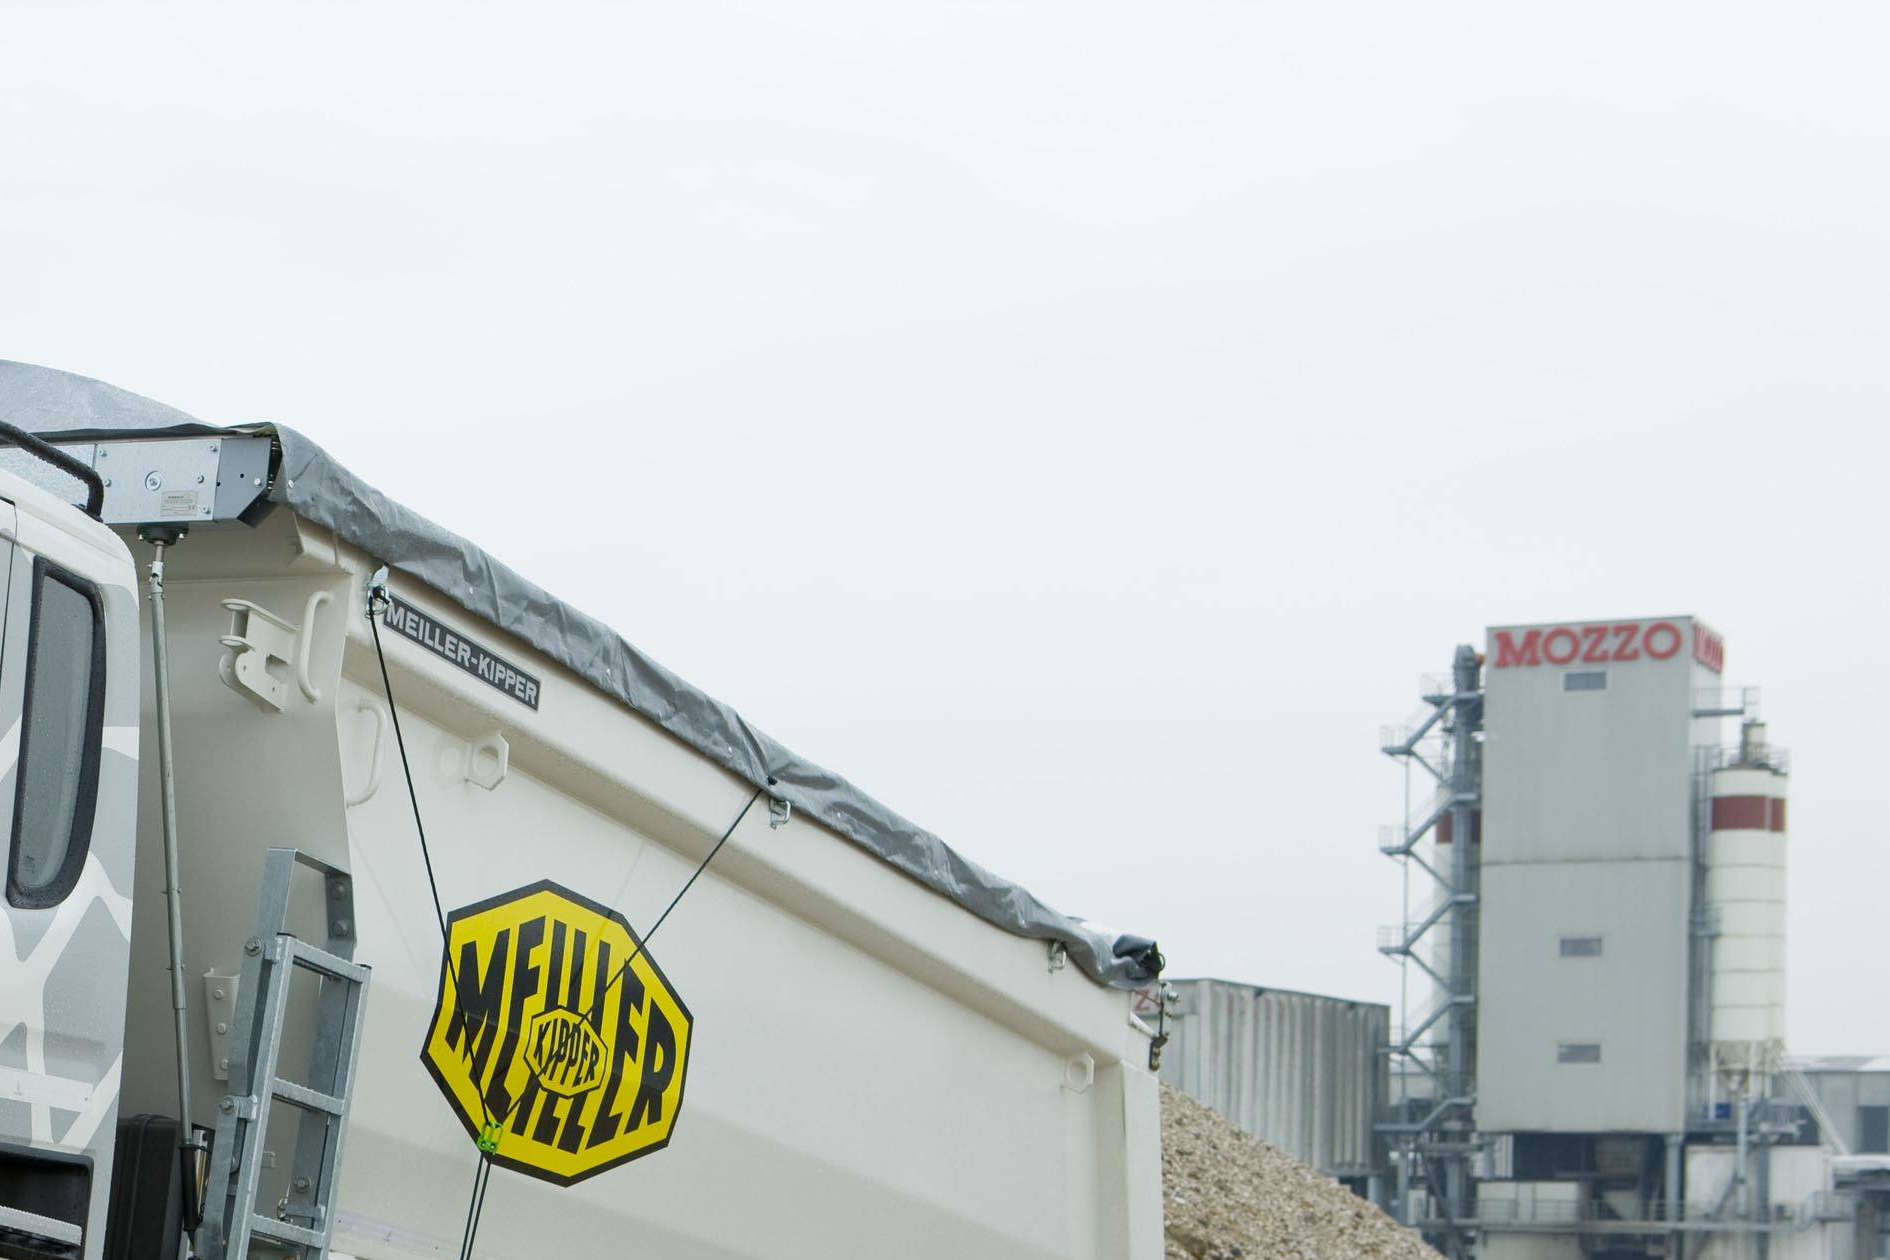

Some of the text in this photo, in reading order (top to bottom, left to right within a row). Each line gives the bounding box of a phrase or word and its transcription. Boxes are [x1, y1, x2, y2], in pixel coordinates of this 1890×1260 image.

[385, 602, 538, 706] MEILLER-KIPPER
[1494, 622, 1683, 668] MOZZO
[445, 915, 677, 1155] MEILLER
[533, 1018, 600, 1088] KIPPER
